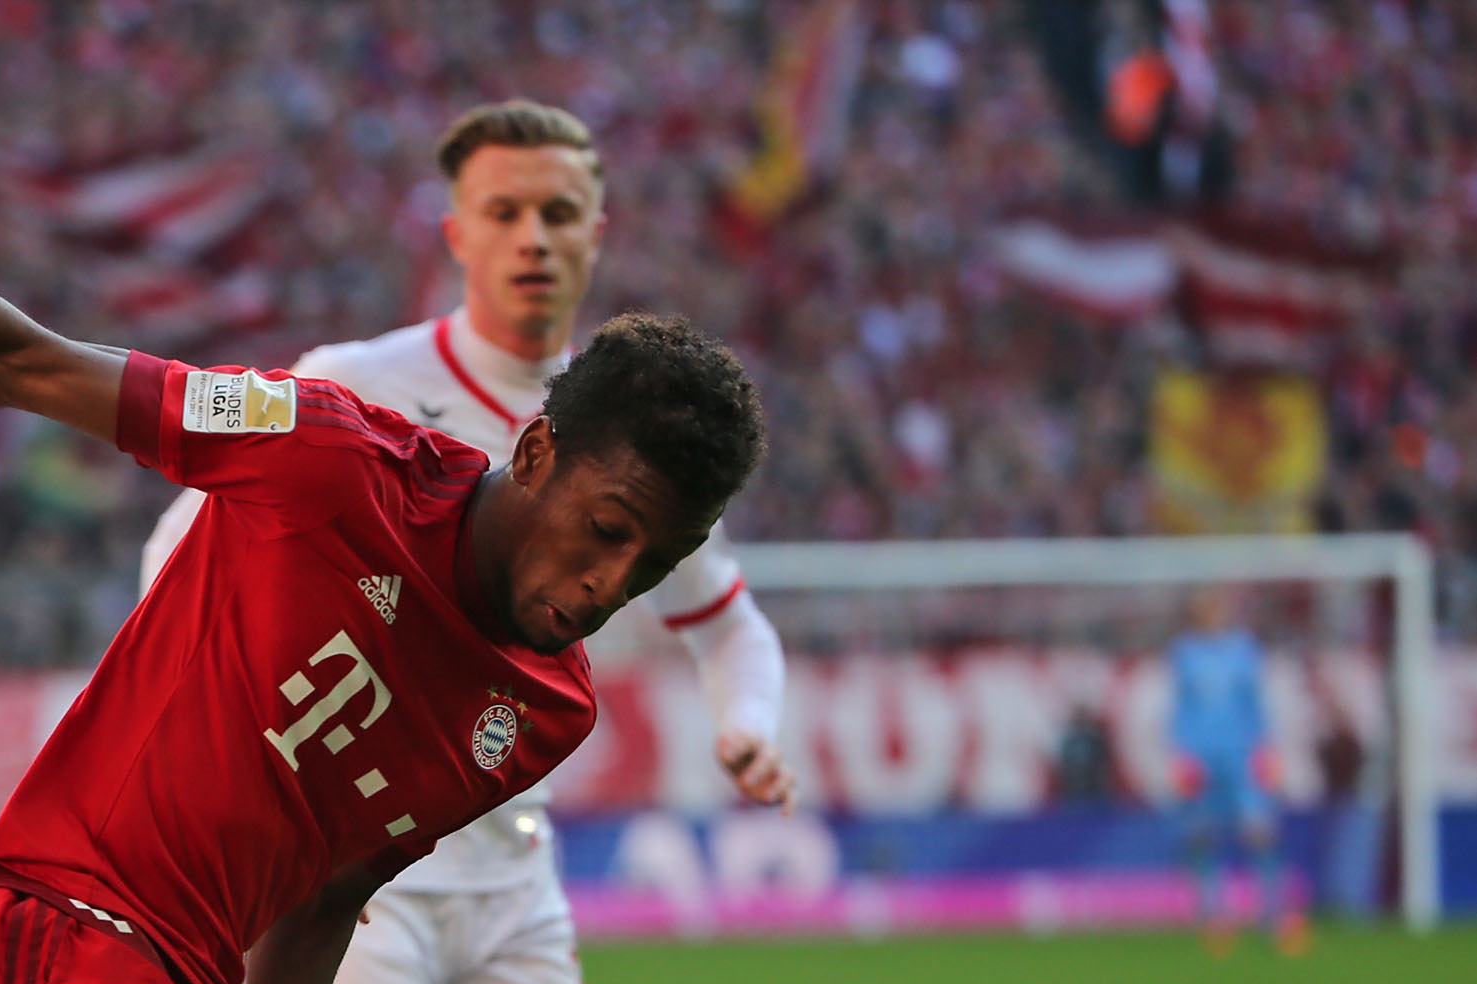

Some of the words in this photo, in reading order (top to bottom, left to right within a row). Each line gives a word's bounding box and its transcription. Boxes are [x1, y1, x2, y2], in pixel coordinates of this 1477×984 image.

[212, 385, 229, 417] LIGA
[226, 376, 245, 429] BUNDES
[356, 577, 397, 625] adidas
[484, 708, 495, 723] FC
[495, 708, 514, 747] BAYERN
